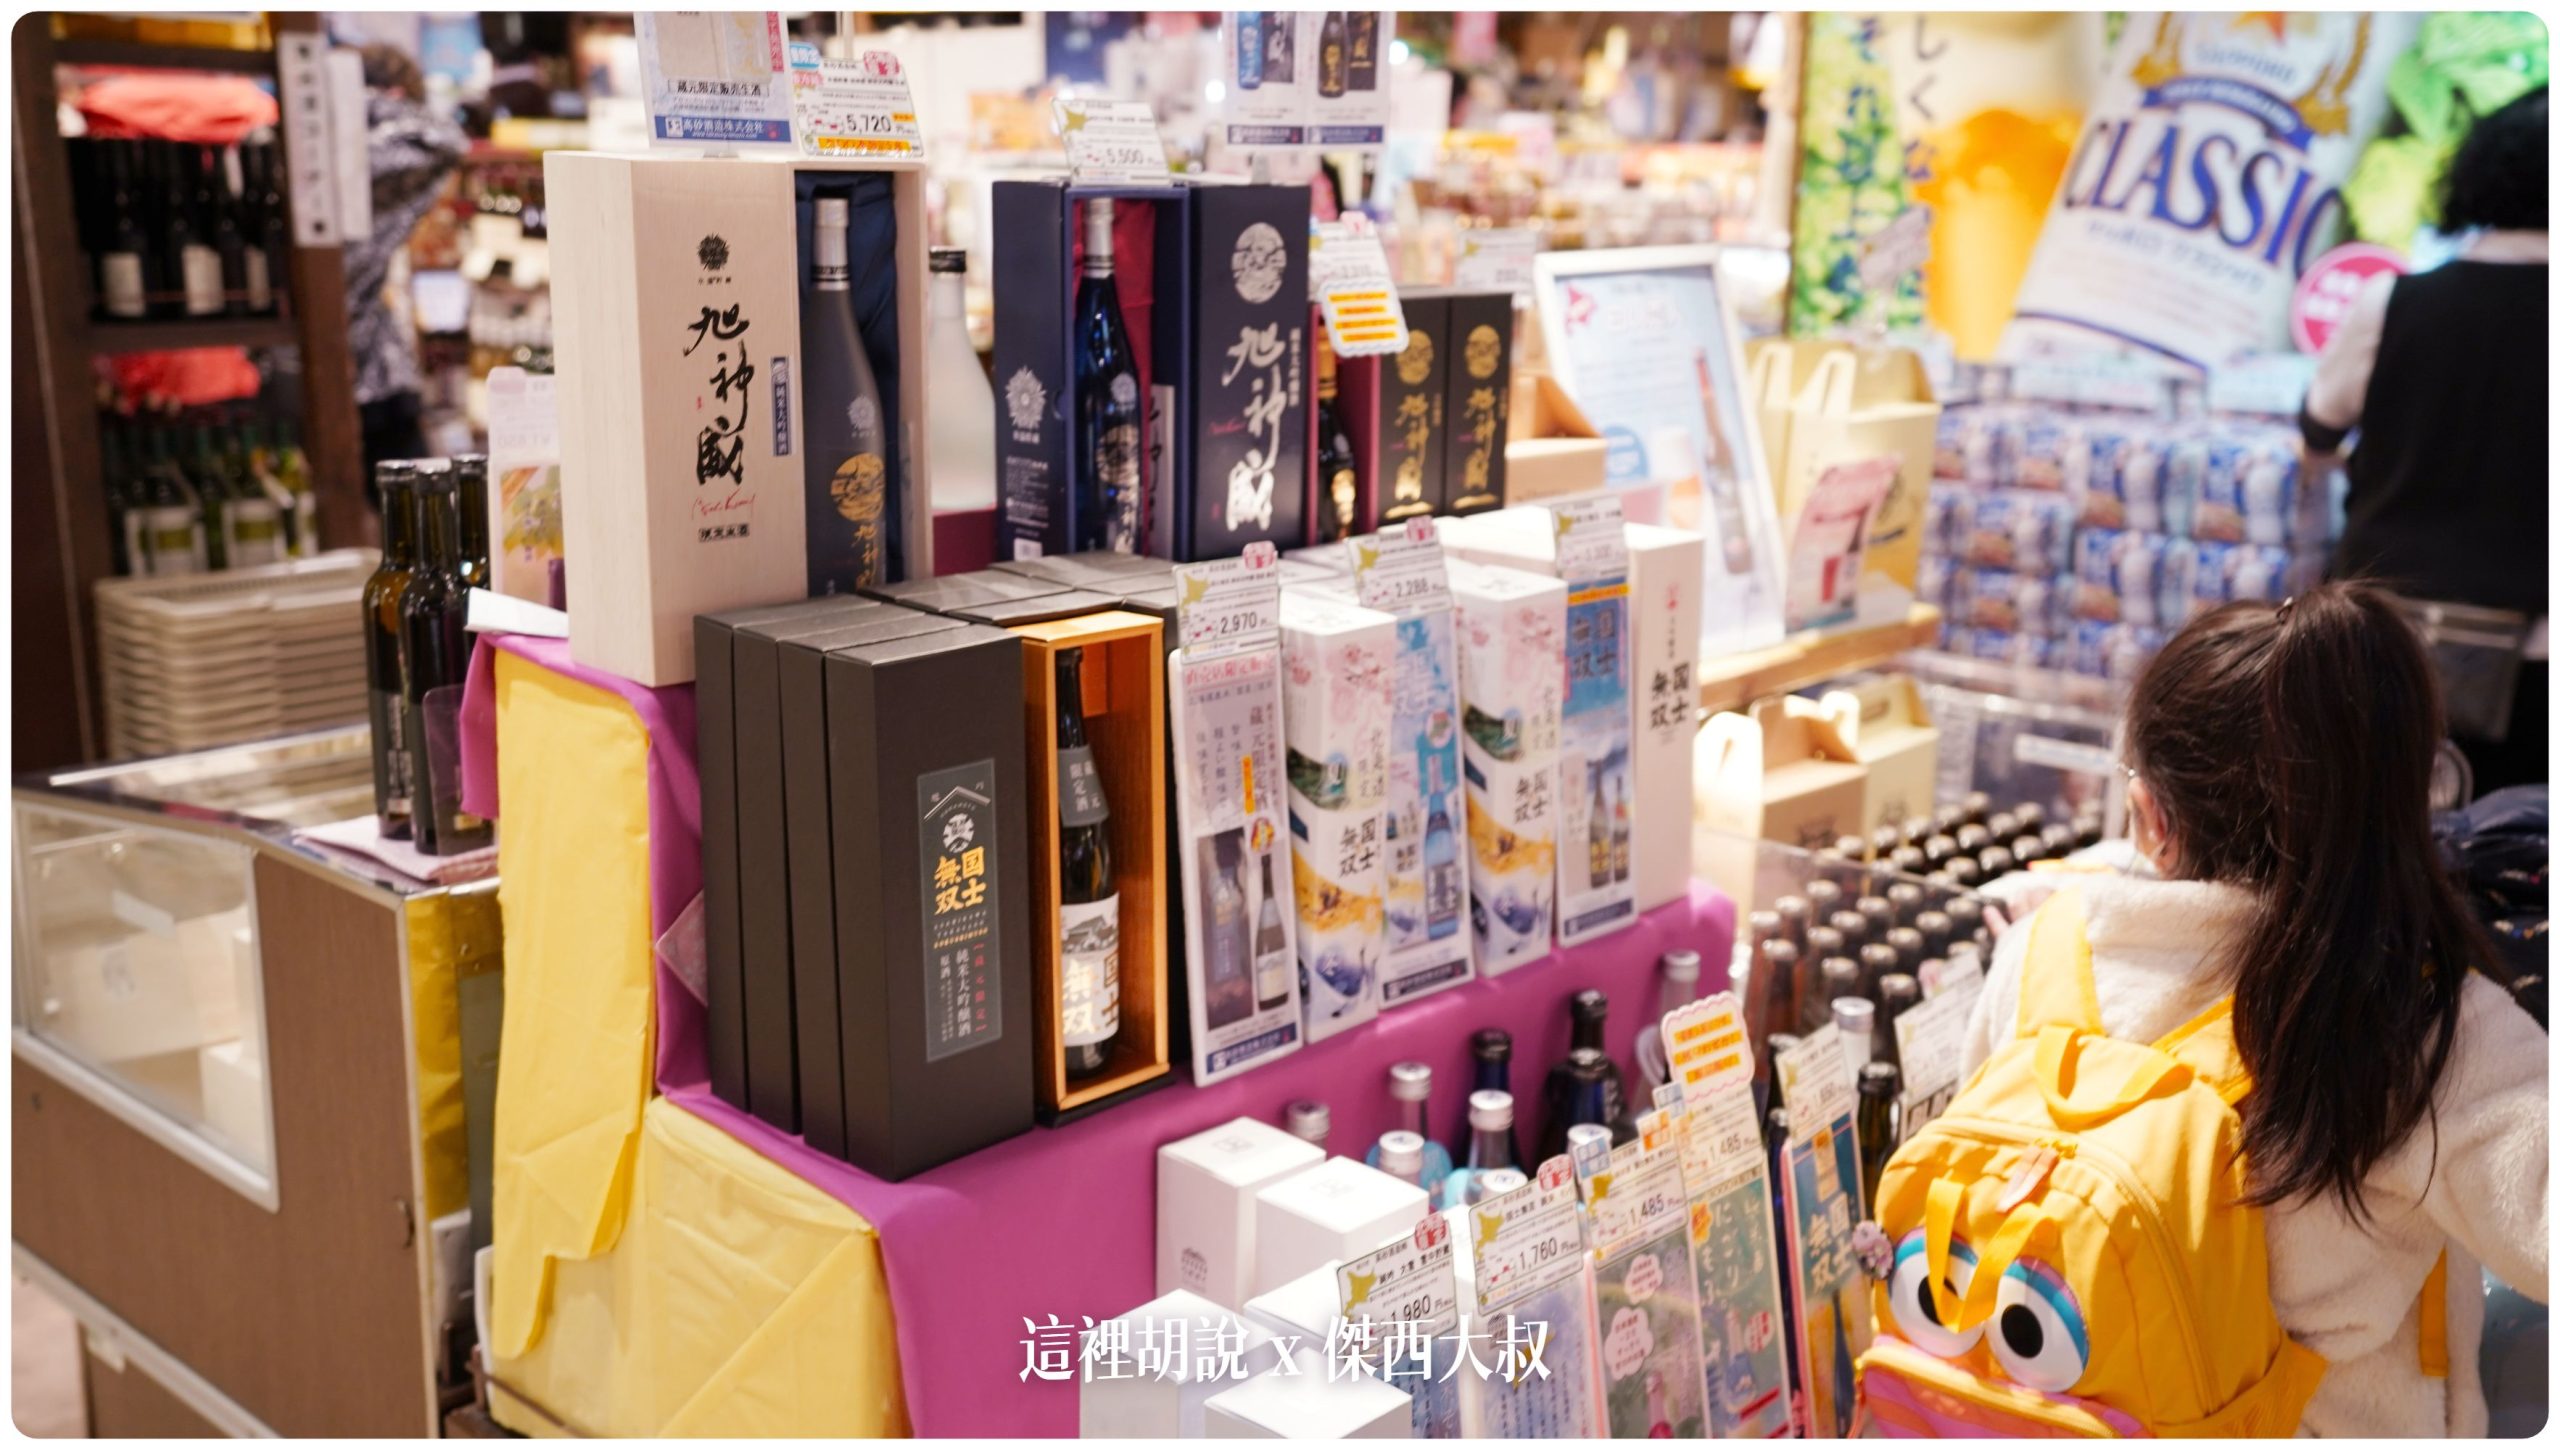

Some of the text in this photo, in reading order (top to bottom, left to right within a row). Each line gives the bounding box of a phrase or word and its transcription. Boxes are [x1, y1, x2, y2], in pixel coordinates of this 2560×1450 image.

[846, 114, 891, 135] 5,720
[1220, 611, 1258, 635] 2,970
[1519, 1236, 1558, 1270] 1,760
[1389, 1294, 1431, 1331] 1980
